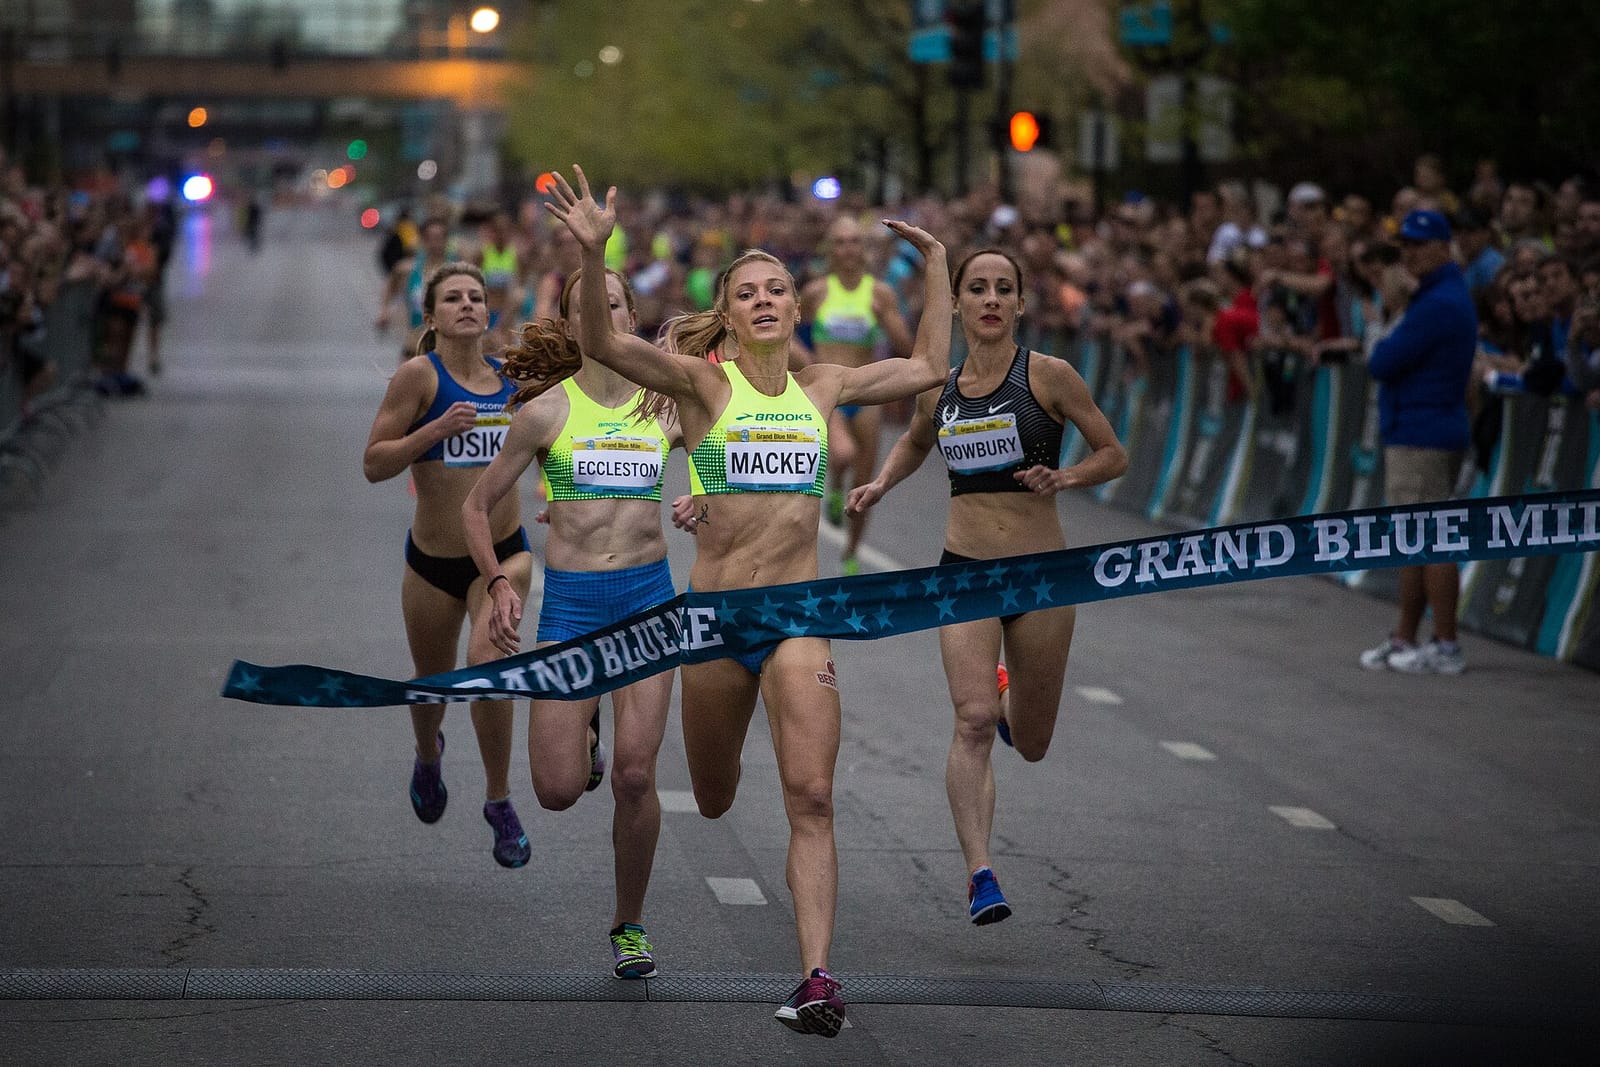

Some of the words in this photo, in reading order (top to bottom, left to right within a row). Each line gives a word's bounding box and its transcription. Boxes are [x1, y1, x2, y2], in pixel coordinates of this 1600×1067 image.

[755, 413, 813, 421] BROOKS
[447, 431, 502, 457] OSIK
[943, 436, 1016, 461] ROWBURY
[578, 461, 659, 478] ECCLESTON
[731, 452, 818, 474] MACKEY
[1093, 524, 1295, 588] GRAND
[1314, 508, 1469, 562] BLUE
[593, 616, 680, 678] BLUE
